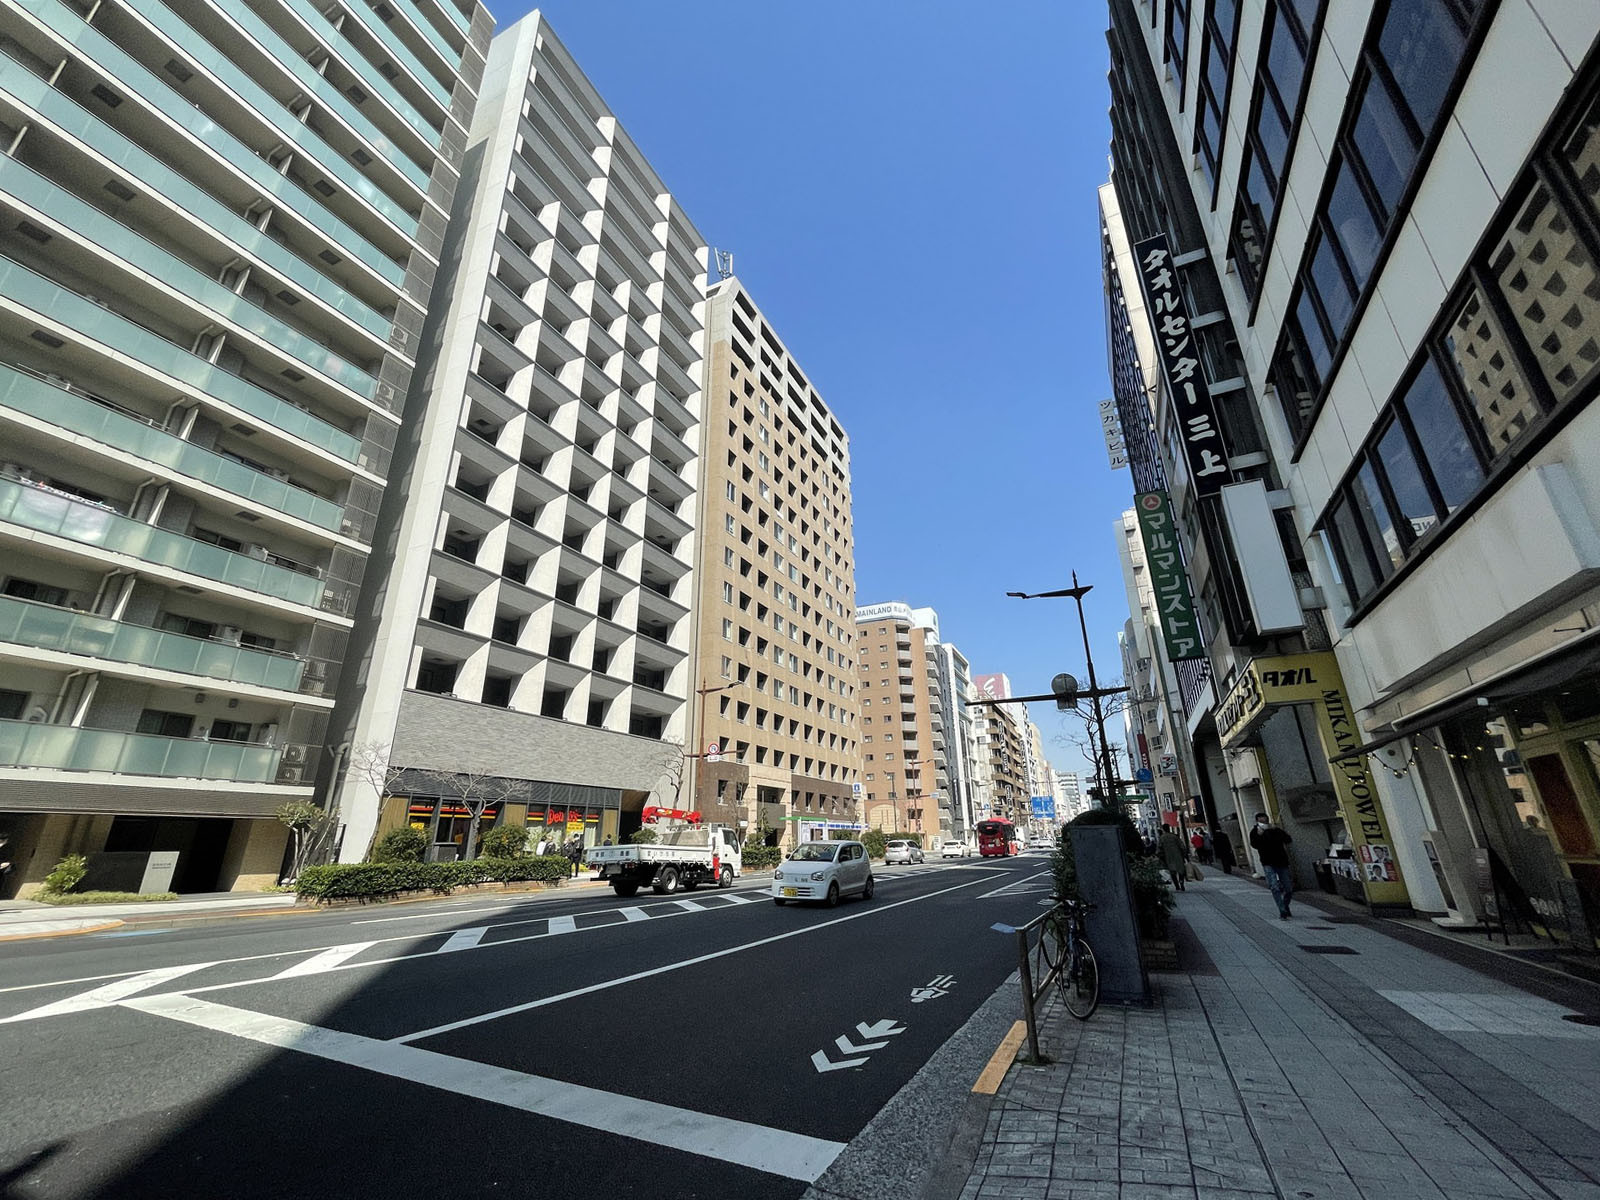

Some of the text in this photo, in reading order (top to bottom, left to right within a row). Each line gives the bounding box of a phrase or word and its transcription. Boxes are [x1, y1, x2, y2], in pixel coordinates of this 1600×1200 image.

[1144, 512, 1195, 658] マルマンストア
[1263, 667, 1318, 687] タオル
[1347, 771, 1385, 845] TOWEL
